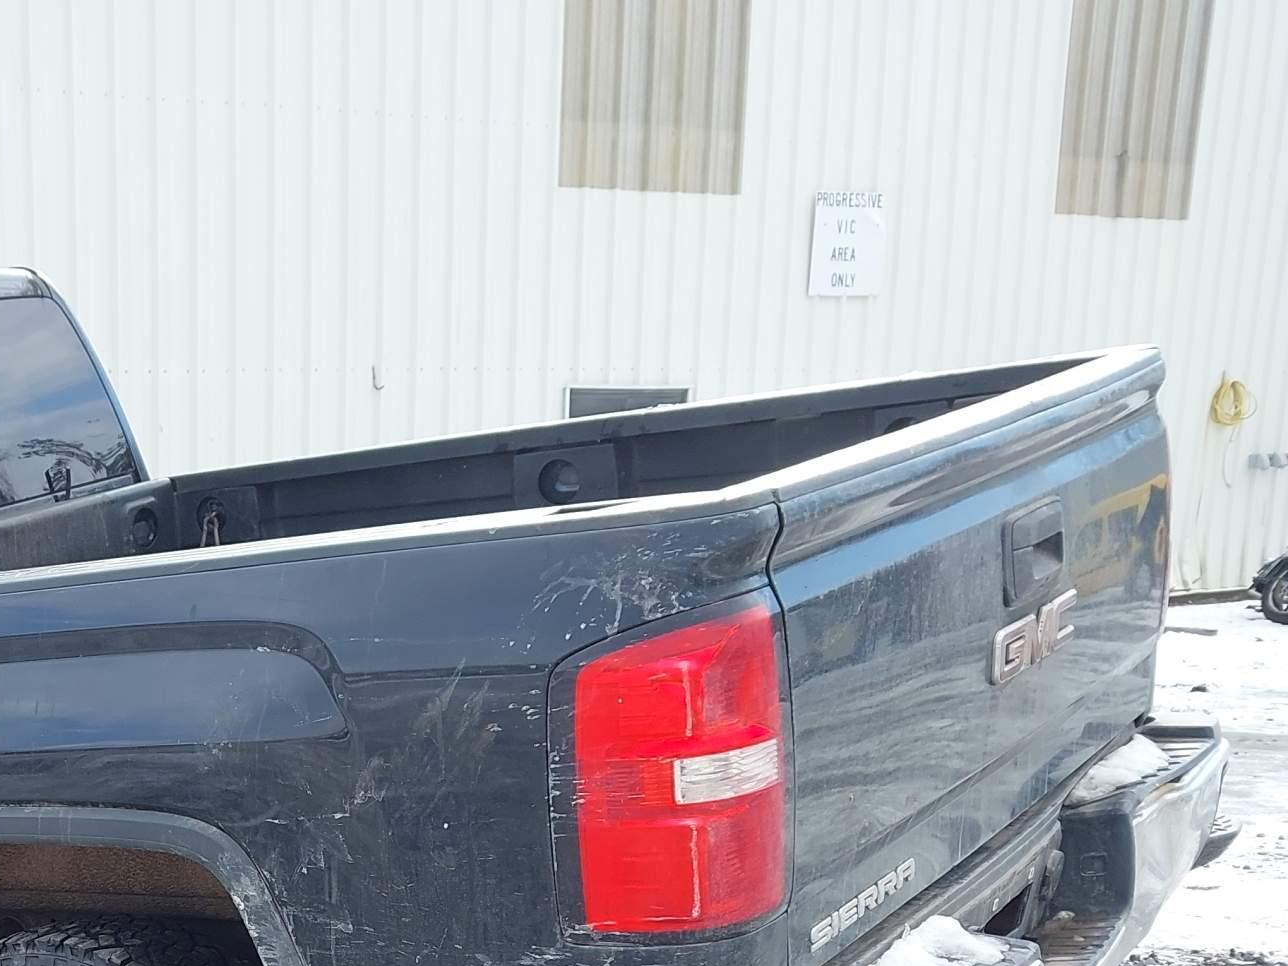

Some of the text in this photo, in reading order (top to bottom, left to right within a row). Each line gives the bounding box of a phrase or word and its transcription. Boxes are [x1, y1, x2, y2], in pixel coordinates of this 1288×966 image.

[817, 191, 883, 208] PROGRESSIVE
[837, 218, 857, 234] VIC
[831, 246, 856, 262] AREA
[831, 272, 856, 288] ONLY
[993, 588, 1078, 683] GMC
[810, 857, 916, 953] SIERRA
